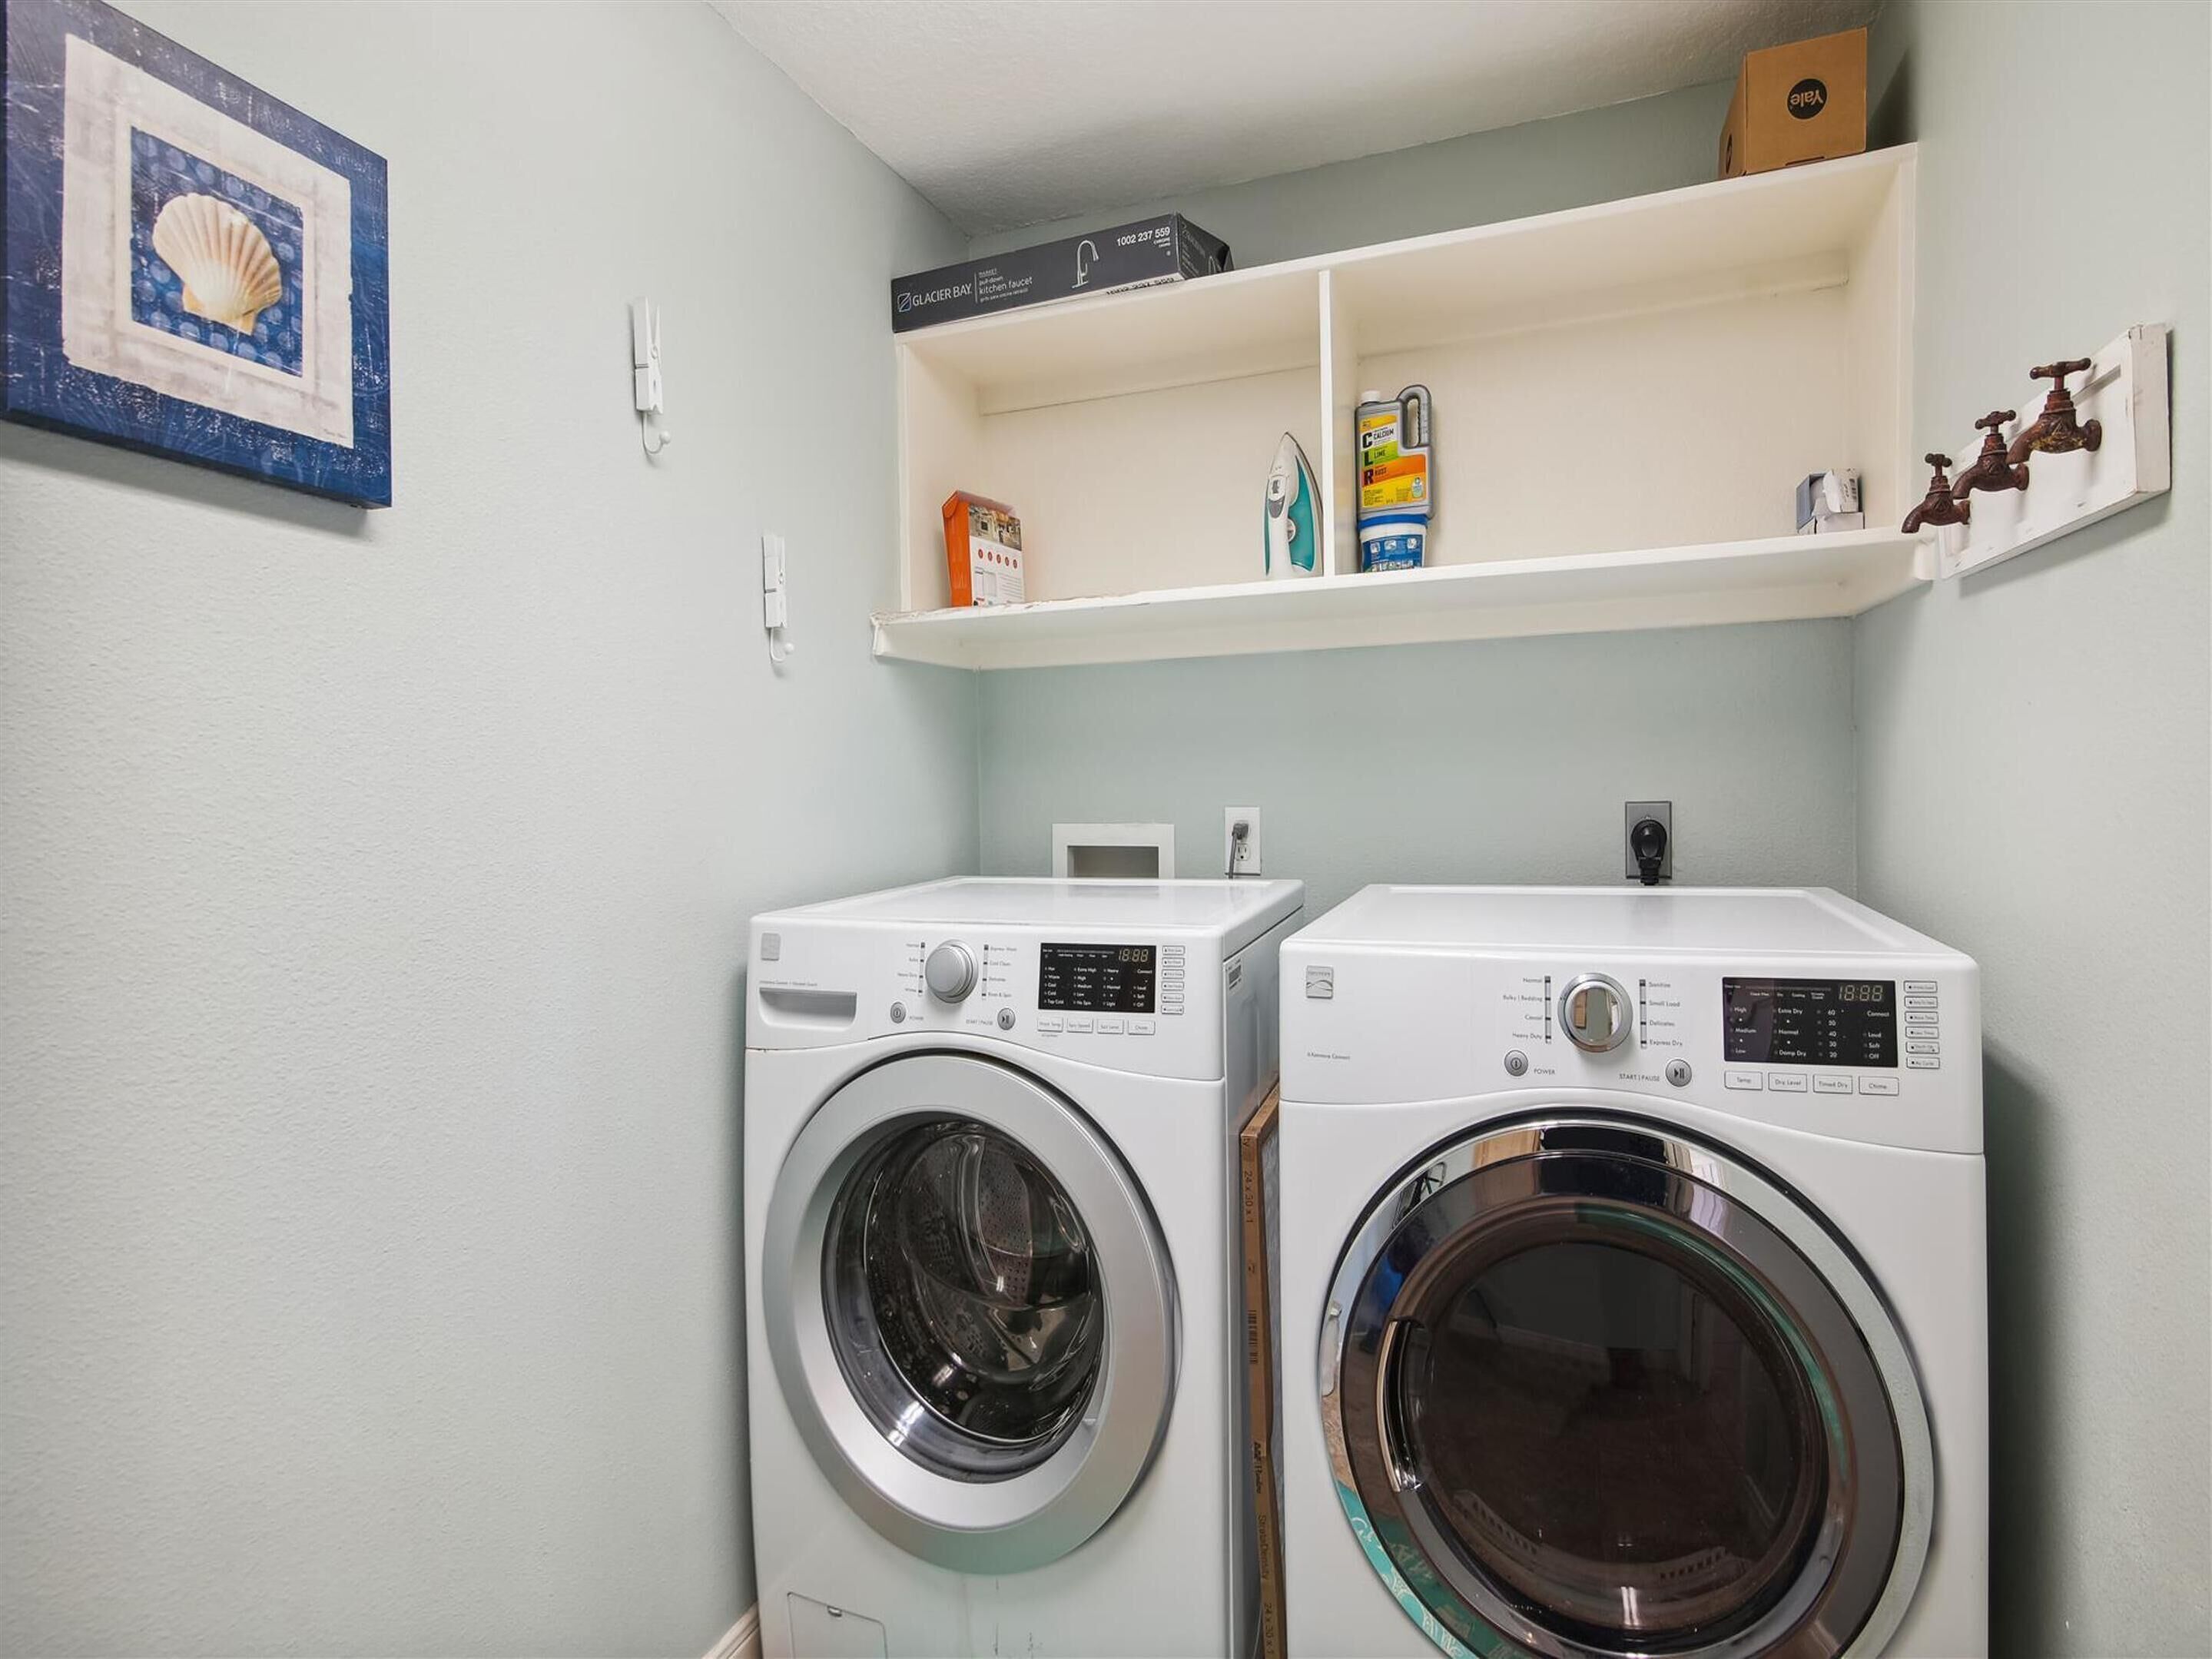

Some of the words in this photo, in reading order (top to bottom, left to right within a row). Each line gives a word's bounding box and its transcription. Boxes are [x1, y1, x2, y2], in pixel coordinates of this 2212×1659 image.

[1790, 89, 1824, 107] Yale
[1117, 234, 1136, 247] 1002
[1137, 231, 1152, 242] 237
[1155, 227, 1170, 237] 559
[979, 282, 1007, 294] kitchen
[1008, 276, 1033, 289] faucet
[912, 288, 951, 307] GLACIER
[953, 283, 972, 297] BAY
[1362, 432, 1372, 448] C
[1374, 428, 1395, 440] CALCIUM
[1364, 451, 1374, 466] L
[1375, 450, 1385, 458] LIME
[1364, 469, 1374, 486] R
[1375, 467, 1387, 476] RUST
[1244, 1170, 1253, 1183] 24
[1245, 1194, 1253, 1207] 30
[1258, 1515, 1269, 1580] StrataDensity
[1264, 1602, 1272, 1614] 24
[1265, 1626, 1274, 1637] 30
